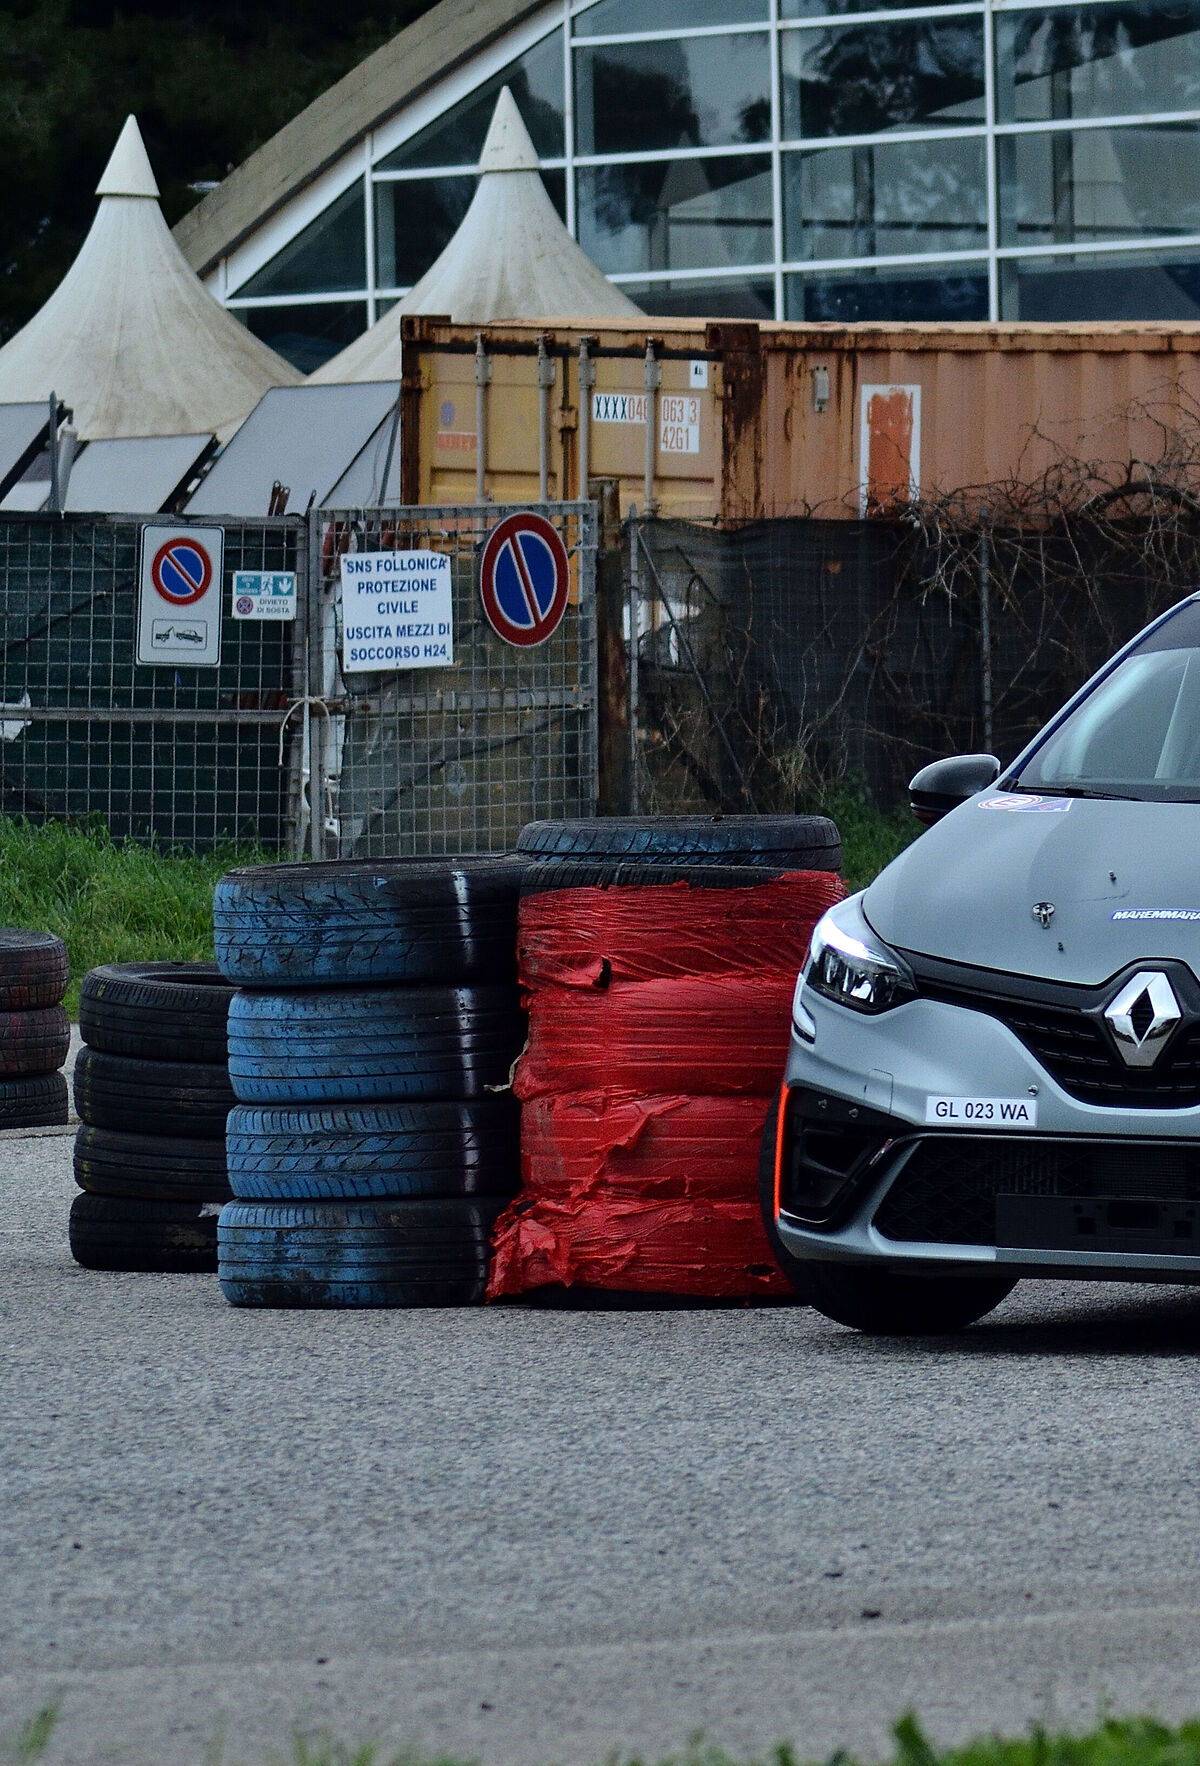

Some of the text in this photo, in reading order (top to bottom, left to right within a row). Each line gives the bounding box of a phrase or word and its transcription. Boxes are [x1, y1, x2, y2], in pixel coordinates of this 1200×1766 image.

[662, 399, 685, 421] 063
[690, 400, 697, 424] 3
[662, 426, 690, 451] 42G1
[346, 557, 446, 574] SNS FOLLONICA
[357, 578, 437, 595] PROTEZIONE
[377, 600, 419, 615] CIVILE
[346, 622, 450, 641] USCITA MEZZI DI
[350, 643, 447, 662] SOCCORSO H24
[935, 1101, 1029, 1120] GL 023 WA
